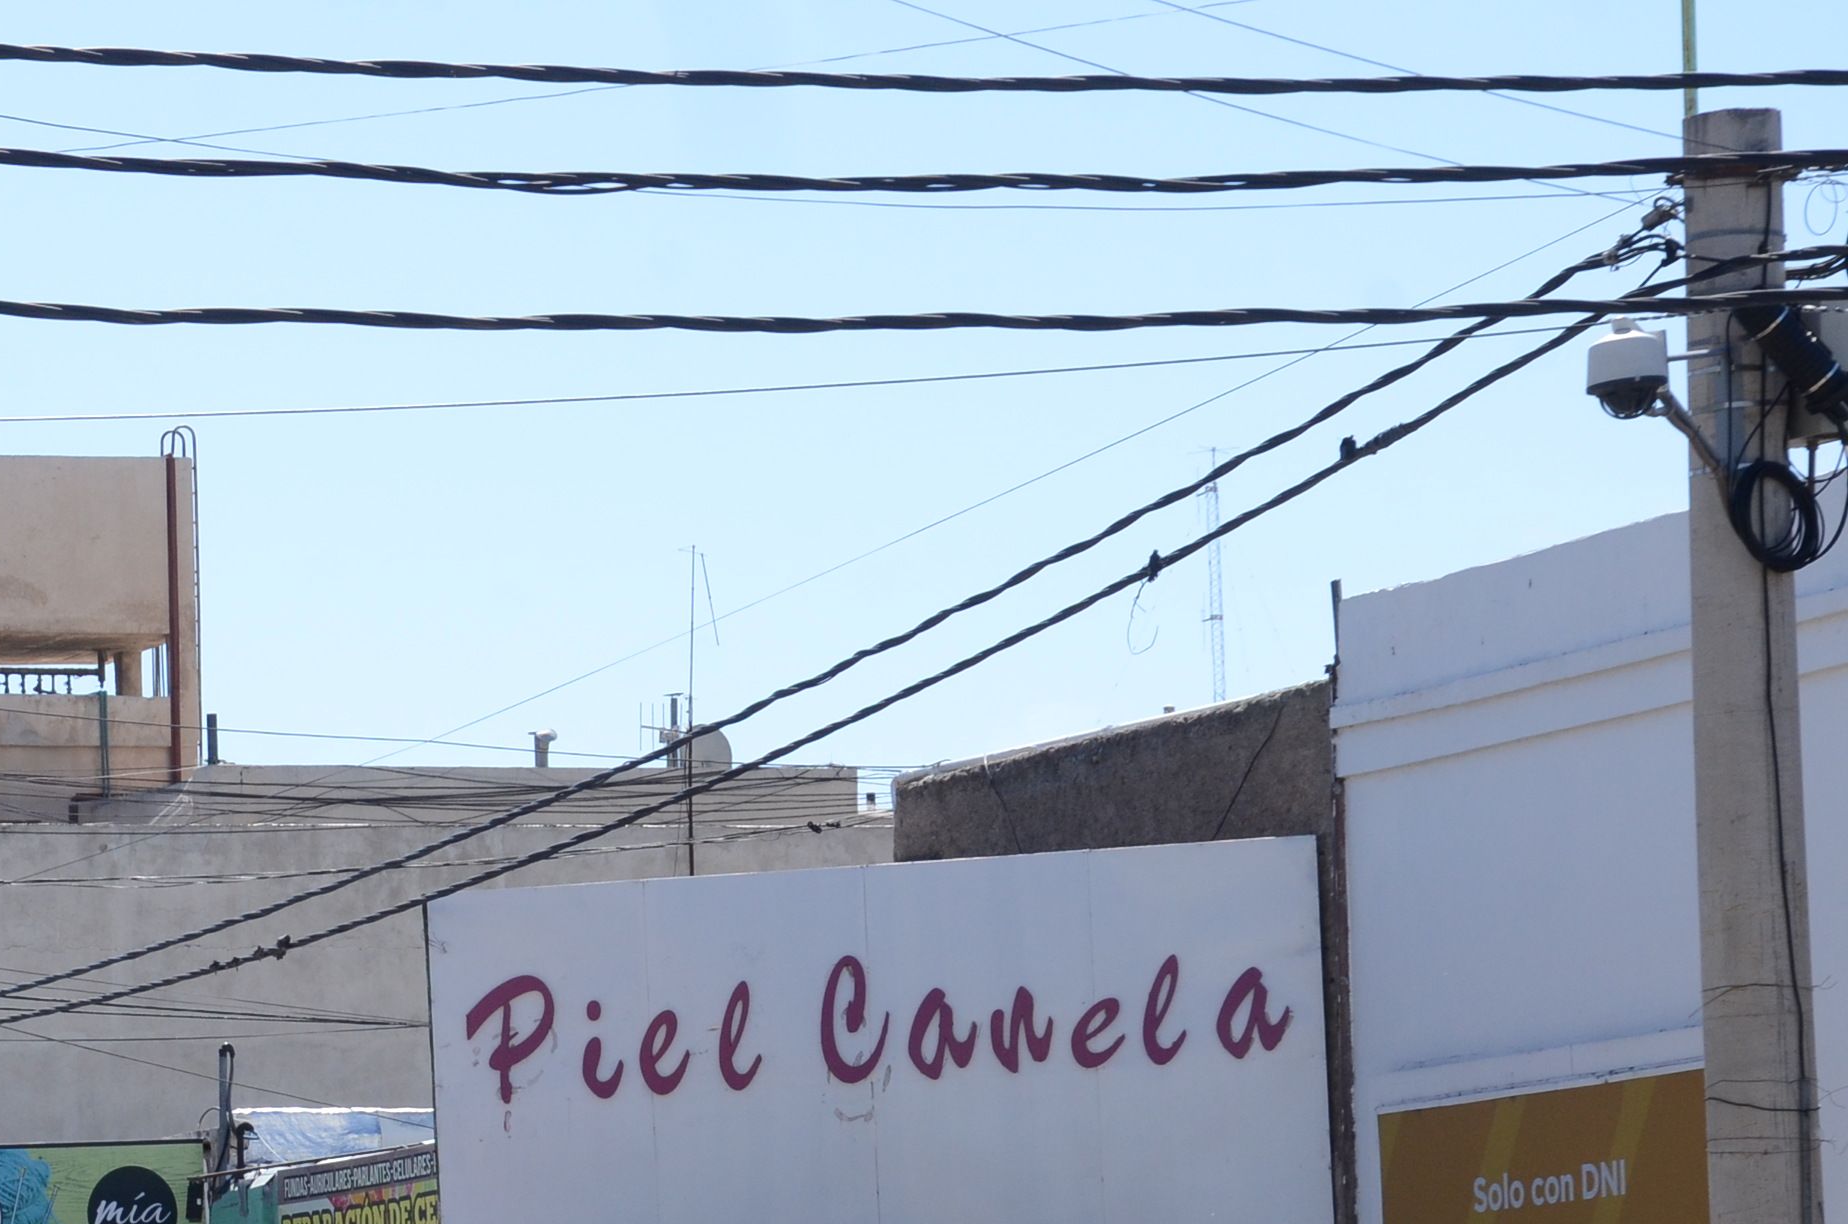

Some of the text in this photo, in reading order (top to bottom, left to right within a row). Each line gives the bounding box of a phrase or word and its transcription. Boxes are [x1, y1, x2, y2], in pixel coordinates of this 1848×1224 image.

[466, 954, 1291, 1103] Piel Canela
[1473, 1159, 1627, 1213] Solo con DNI
